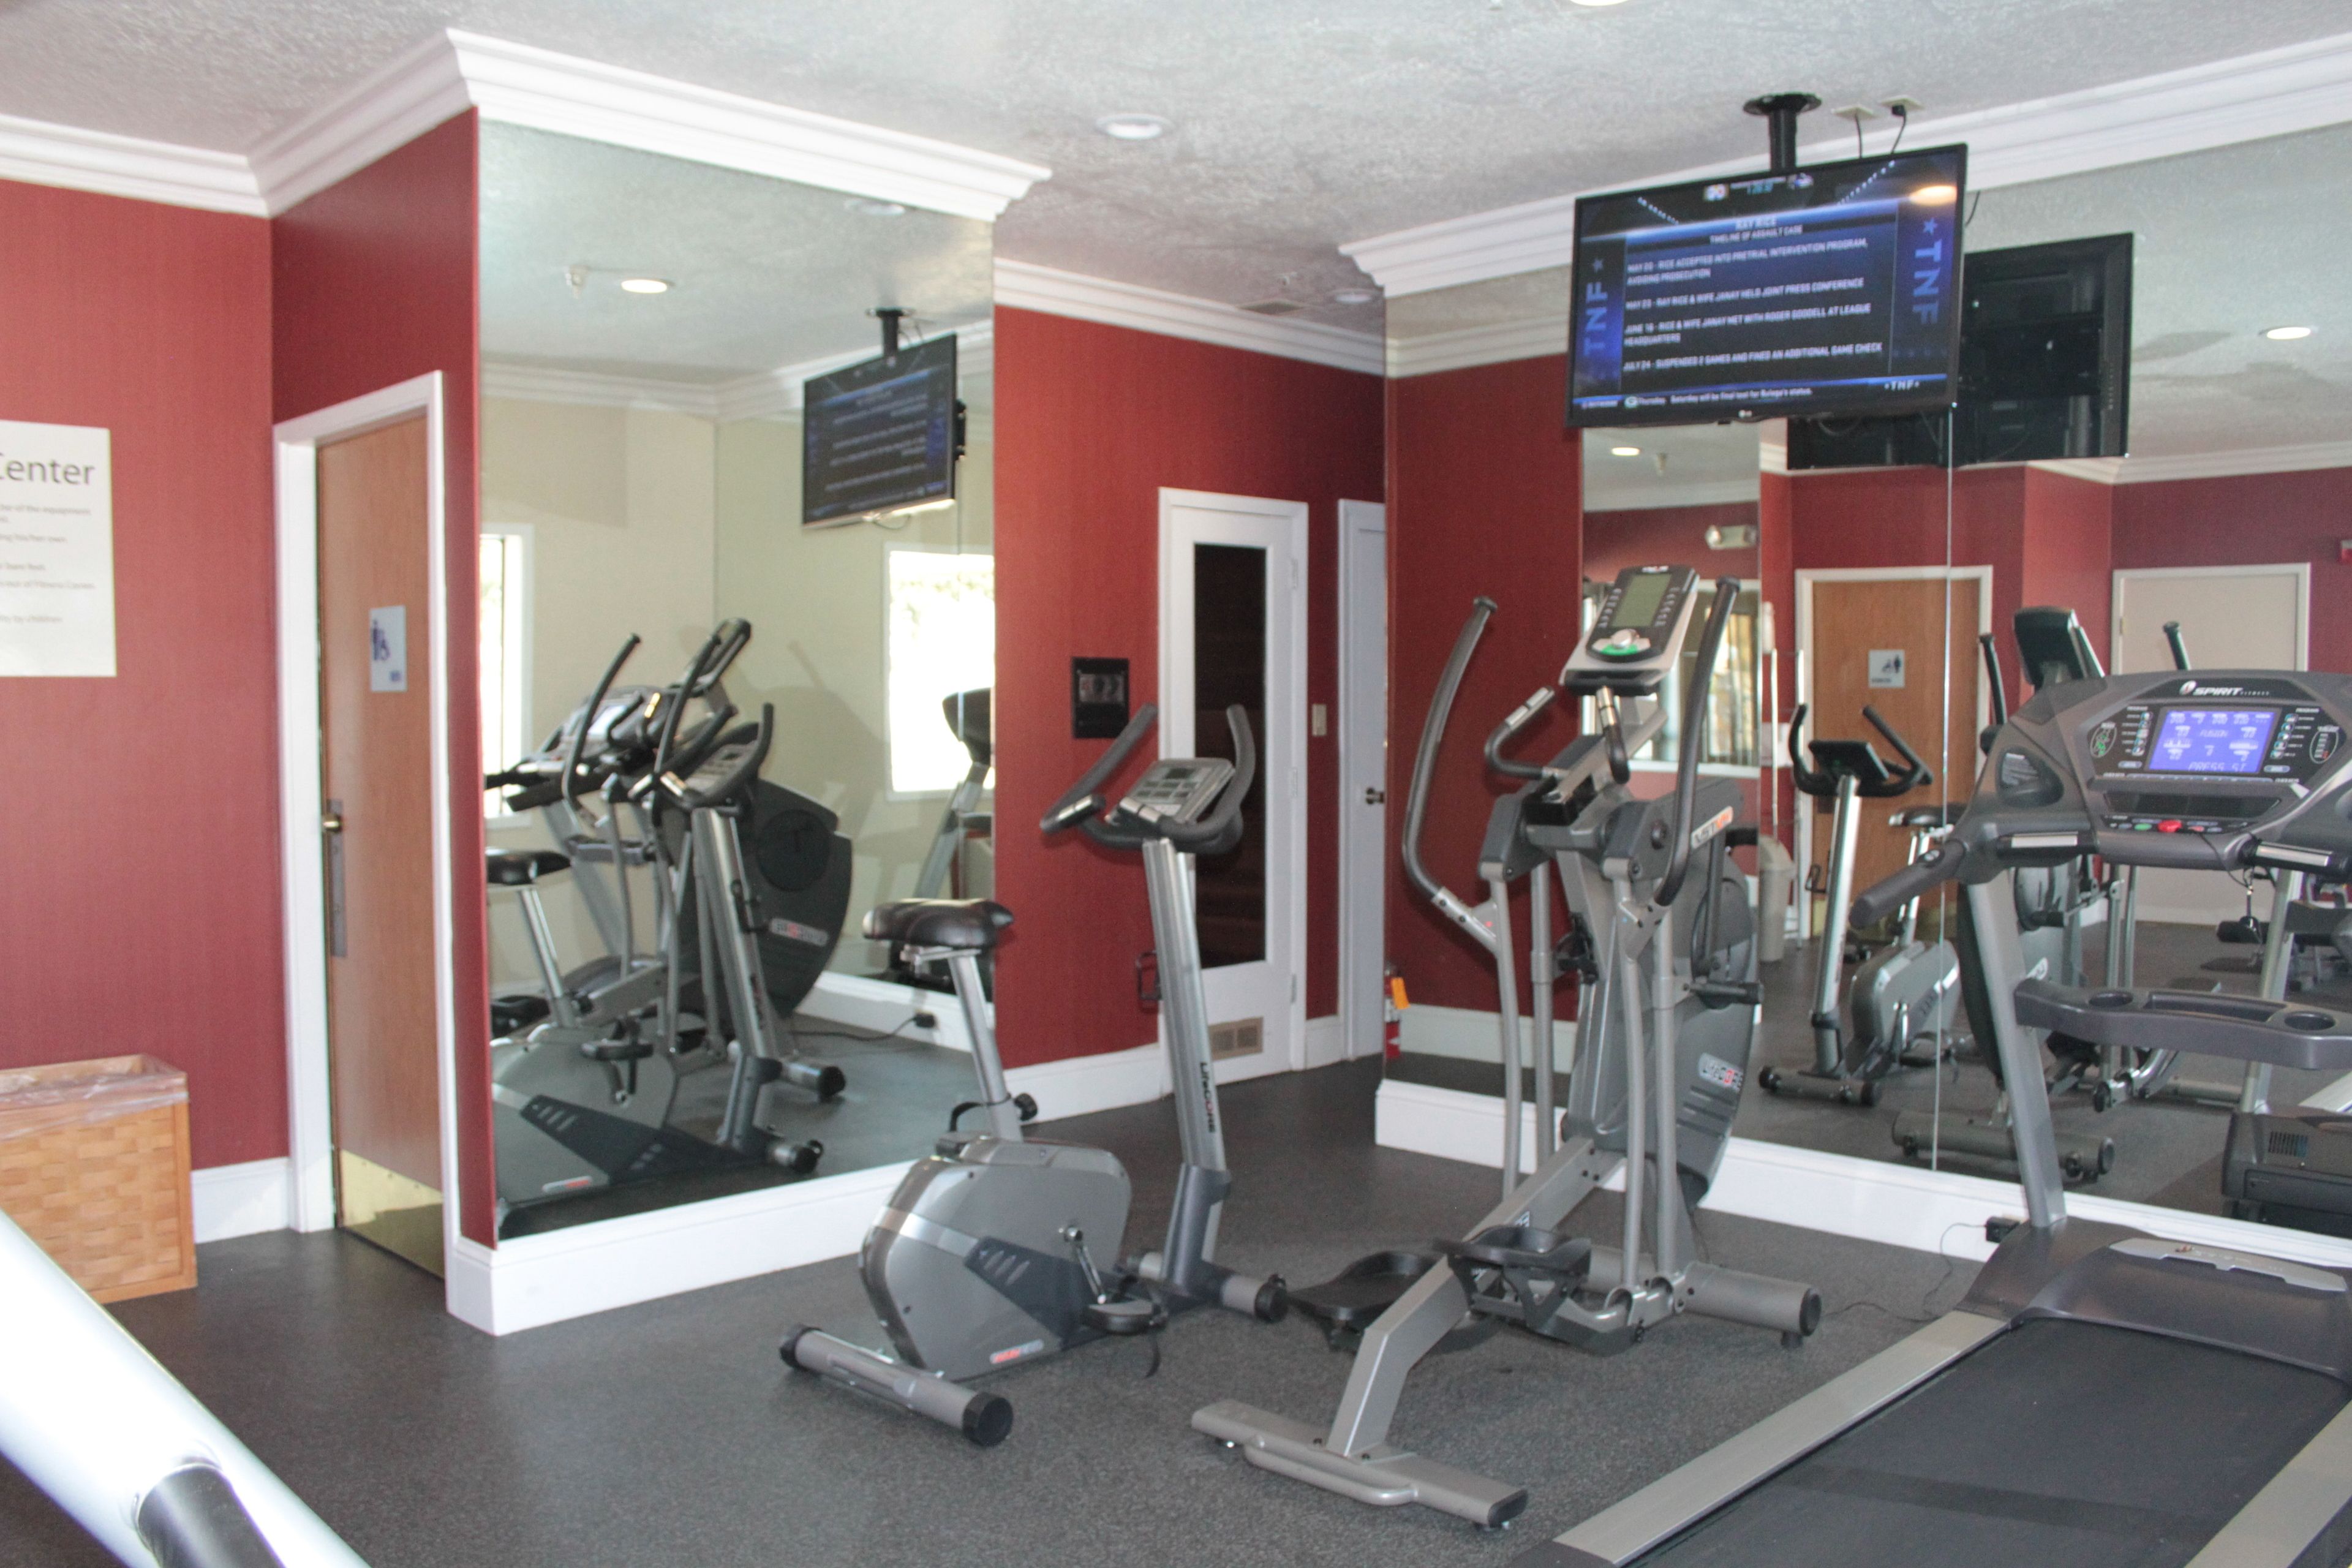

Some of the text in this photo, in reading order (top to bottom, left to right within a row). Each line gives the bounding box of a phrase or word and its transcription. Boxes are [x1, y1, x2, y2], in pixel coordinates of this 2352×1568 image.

[1912, 239, 1942, 324] TNF
[1583, 282, 1608, 356] TNF
[2193, 687, 2244, 696] SPIRIT
